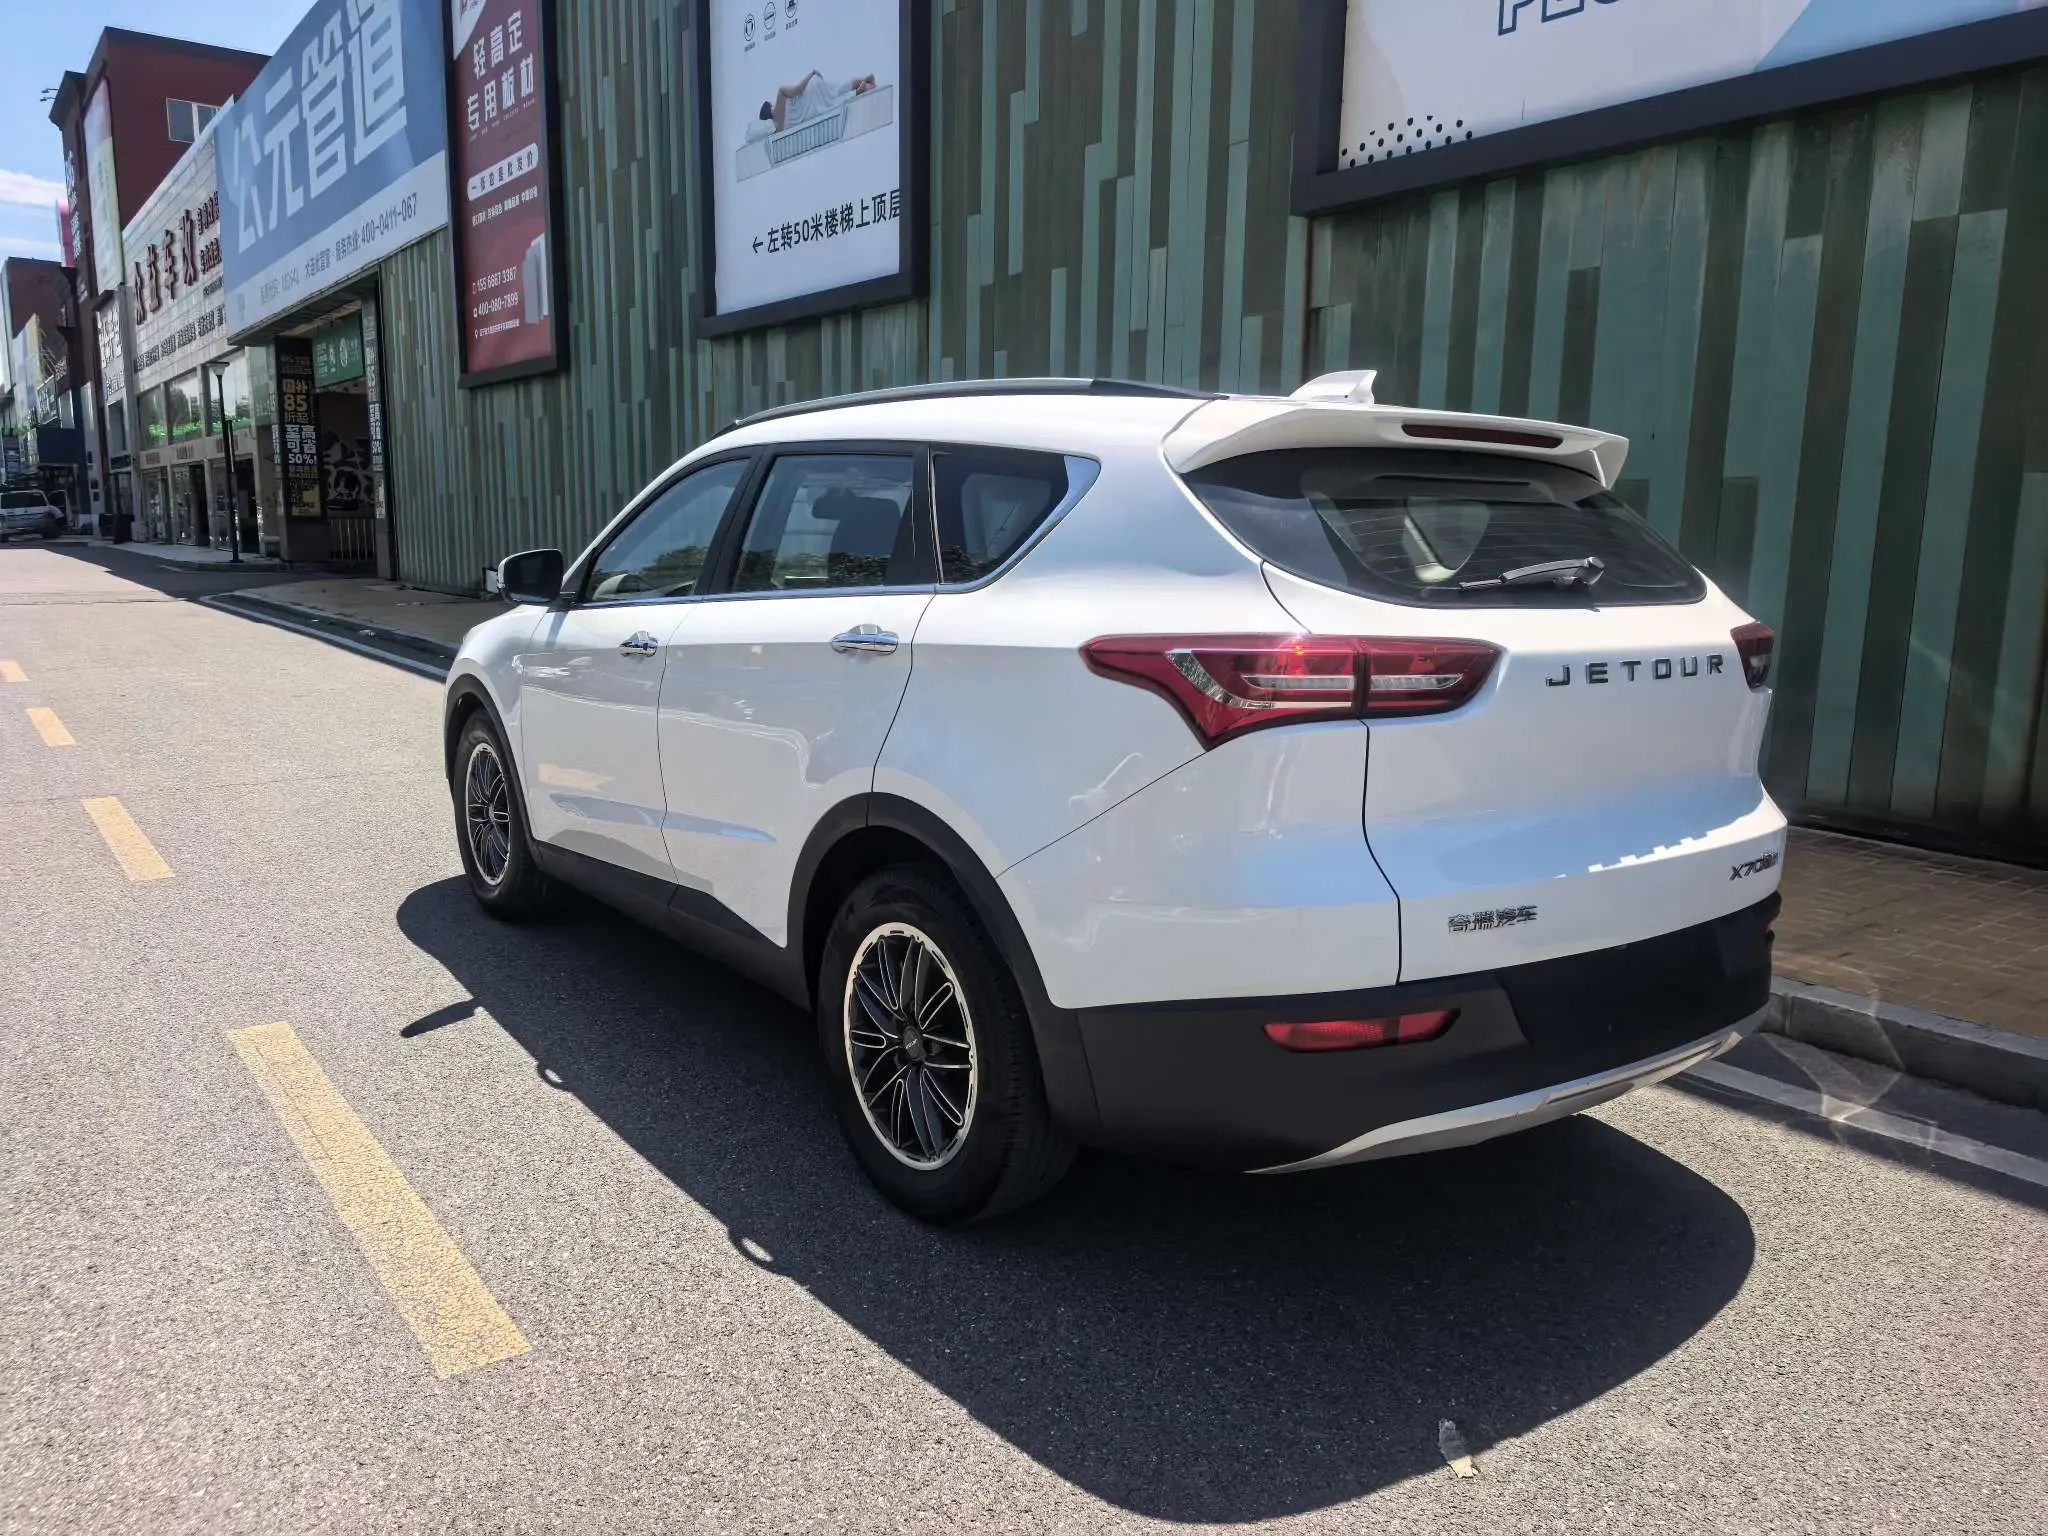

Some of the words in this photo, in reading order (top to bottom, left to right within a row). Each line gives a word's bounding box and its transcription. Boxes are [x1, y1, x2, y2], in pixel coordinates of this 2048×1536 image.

[473, 9, 523, 80] 轻高定
[467, 52, 535, 131] 专用板材
[767, 188, 901, 254] 左转50米楼梯上顶层
[283, 394, 308, 412] 85
[288, 453, 317, 465] 50%!
[1545, 653, 1724, 688] JETOUR
